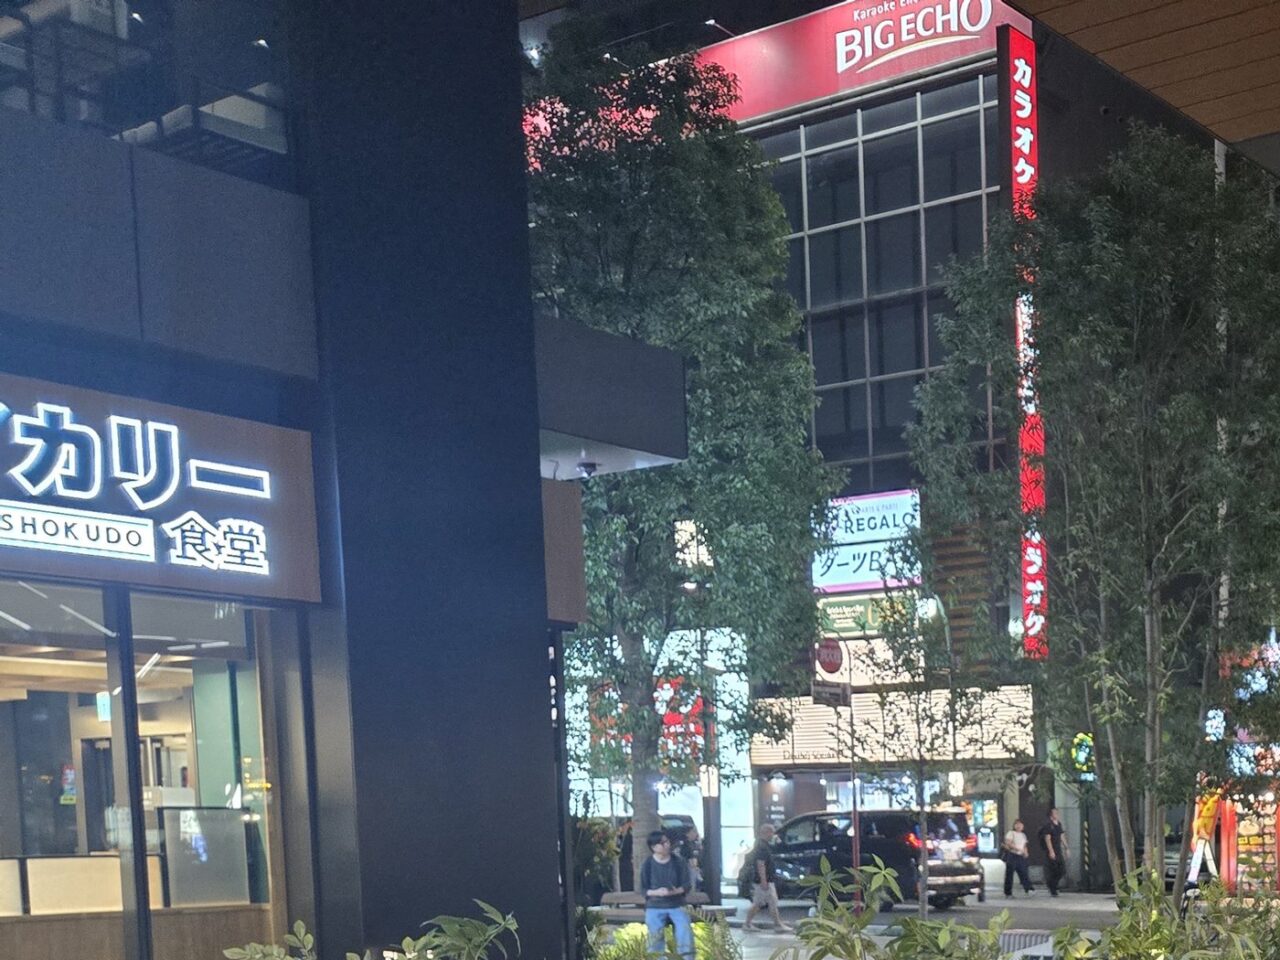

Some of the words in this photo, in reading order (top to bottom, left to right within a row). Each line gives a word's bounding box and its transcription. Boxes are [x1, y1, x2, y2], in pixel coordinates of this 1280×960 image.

[853, 2, 896, 22] Karaoke
[834, 19, 896, 75] BIG
[900, 0, 993, 43] ECHO
[1013, 57, 1036, 185] カラオケ
[0, 513, 143, 547] SHOKUDO
[844, 511, 914, 535] REGALO
[161, 509, 270, 576] 食堂
[820, 549, 911, 577] ダーツBA
